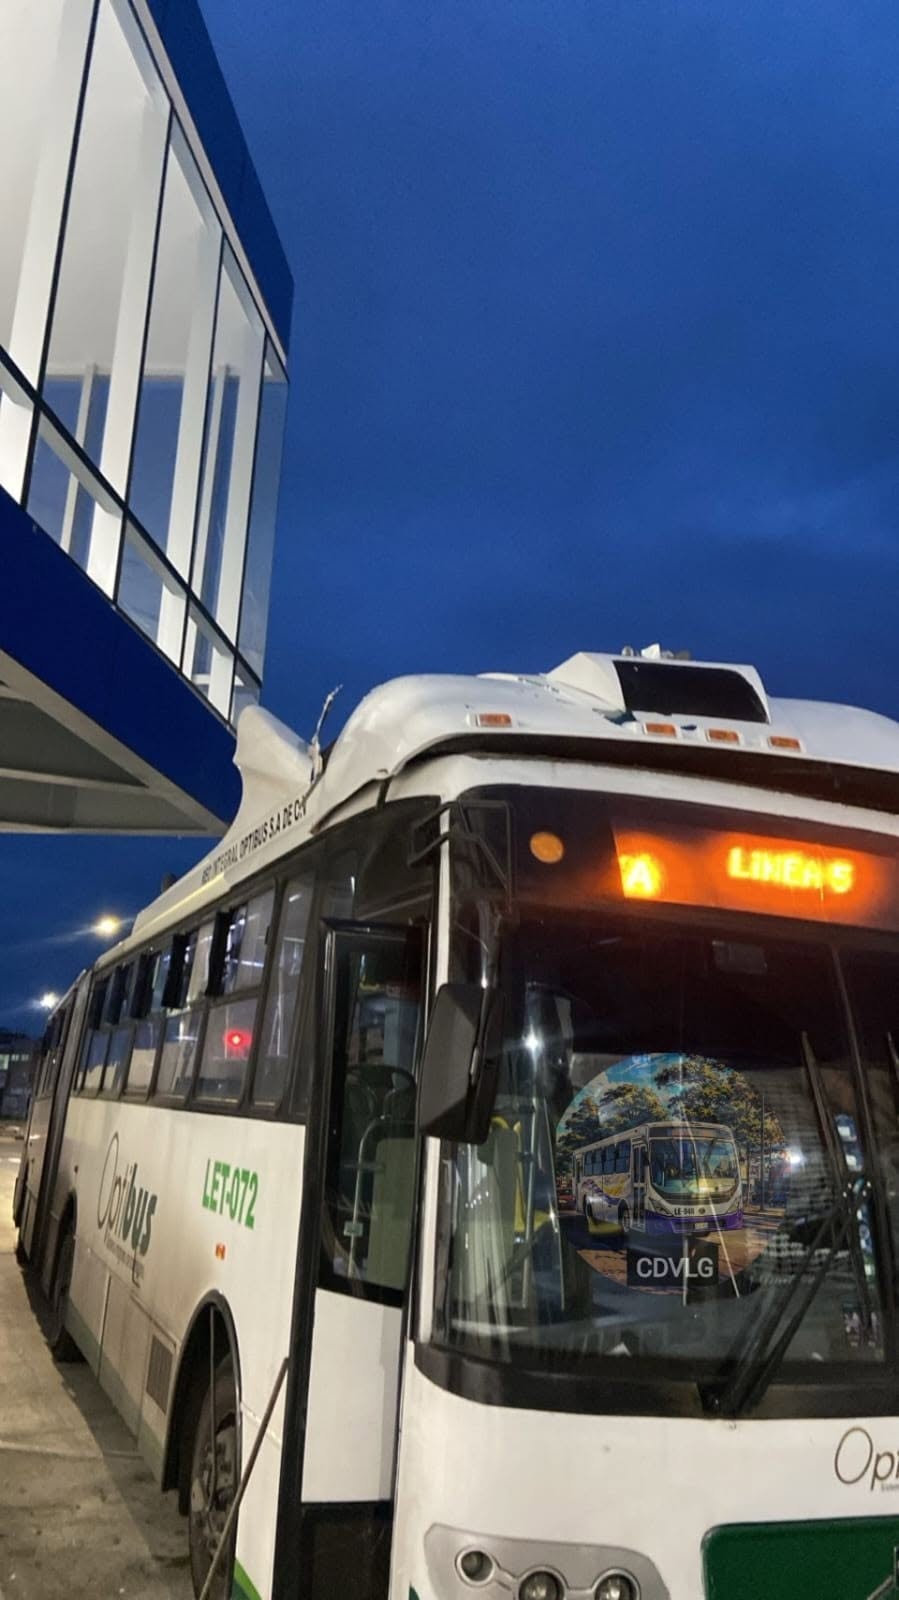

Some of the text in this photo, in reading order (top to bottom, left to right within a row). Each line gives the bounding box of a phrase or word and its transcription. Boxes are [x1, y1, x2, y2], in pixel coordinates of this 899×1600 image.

[239, 822, 268, 860] OPTIBUS
[282, 803, 293, 830] DE
[728, 847, 822, 890] LINEA
[826, 858, 853, 893] 5
[97, 1131, 158, 1257] Optibus
[202, 1158, 258, 1230] LET-072
[834, 1426, 899, 1491] Op
